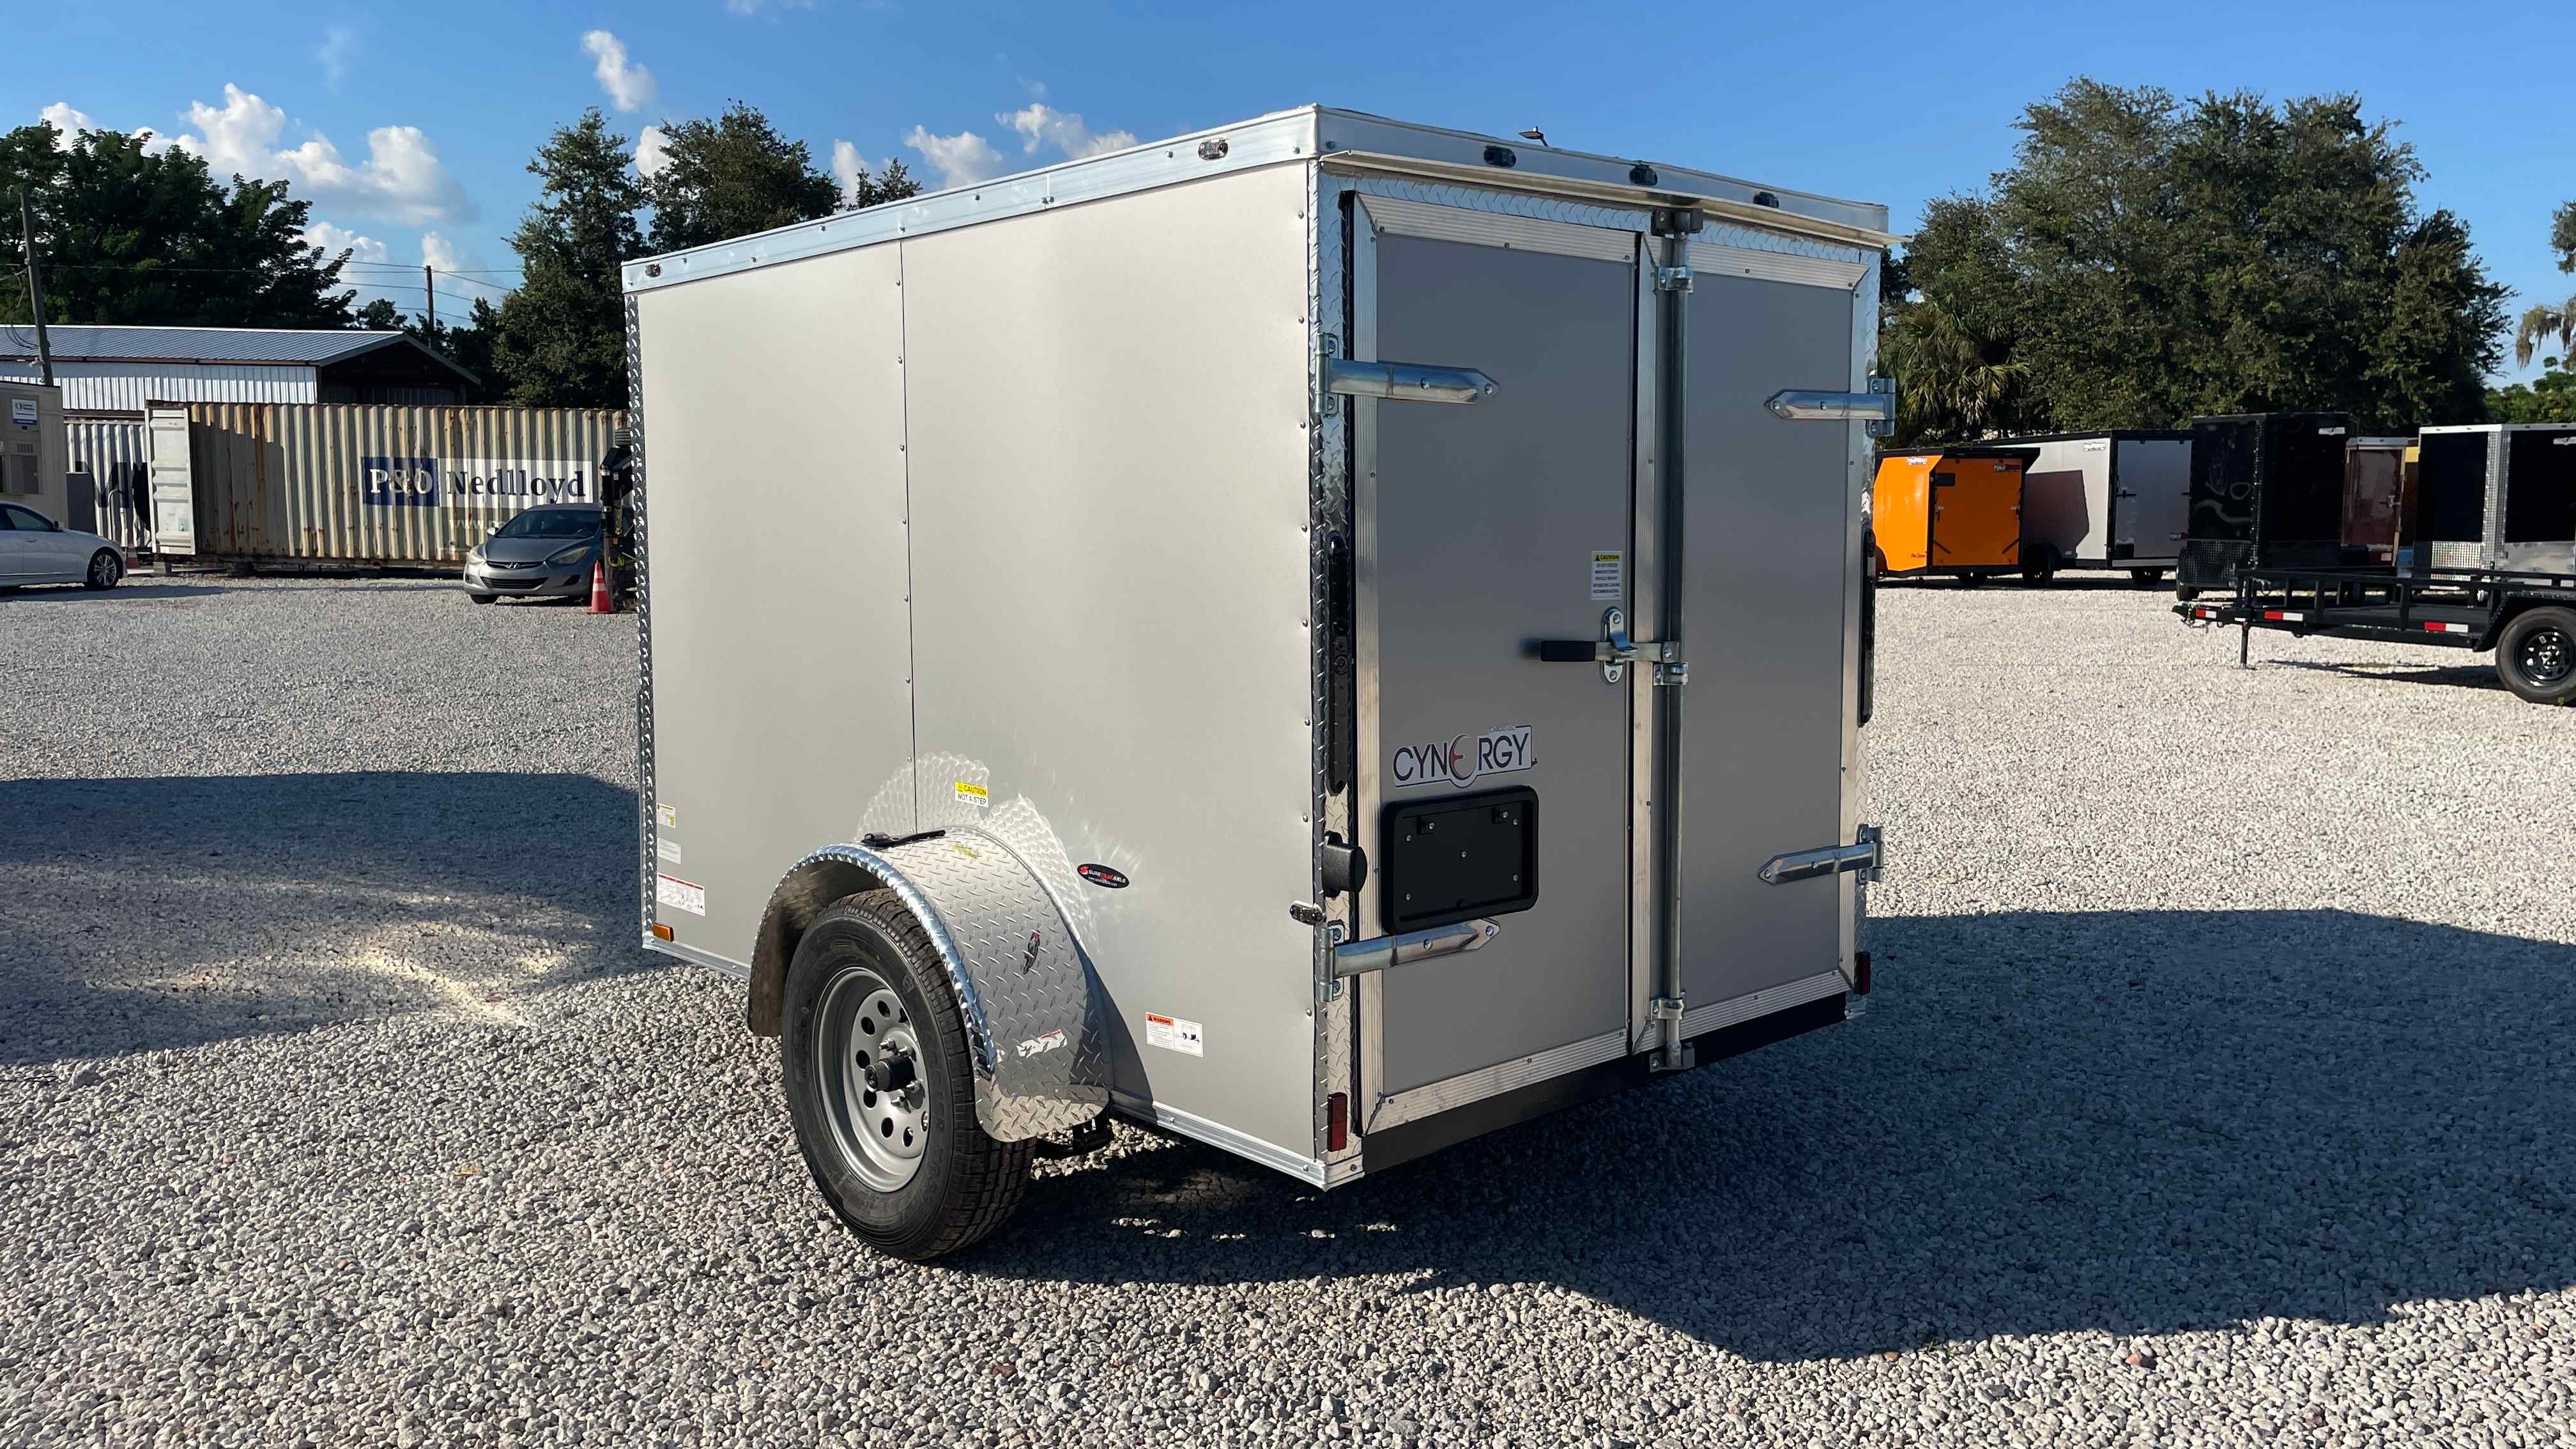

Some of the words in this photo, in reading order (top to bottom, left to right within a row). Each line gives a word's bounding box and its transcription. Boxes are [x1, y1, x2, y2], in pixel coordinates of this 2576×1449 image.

[370, 468, 433, 495] P&O
[447, 468, 586, 503] Nedlloyd
[1393, 733, 1529, 781] CYNERGY
[964, 785, 986, 796] CAUTION
[974, 796, 986, 805] STEP
